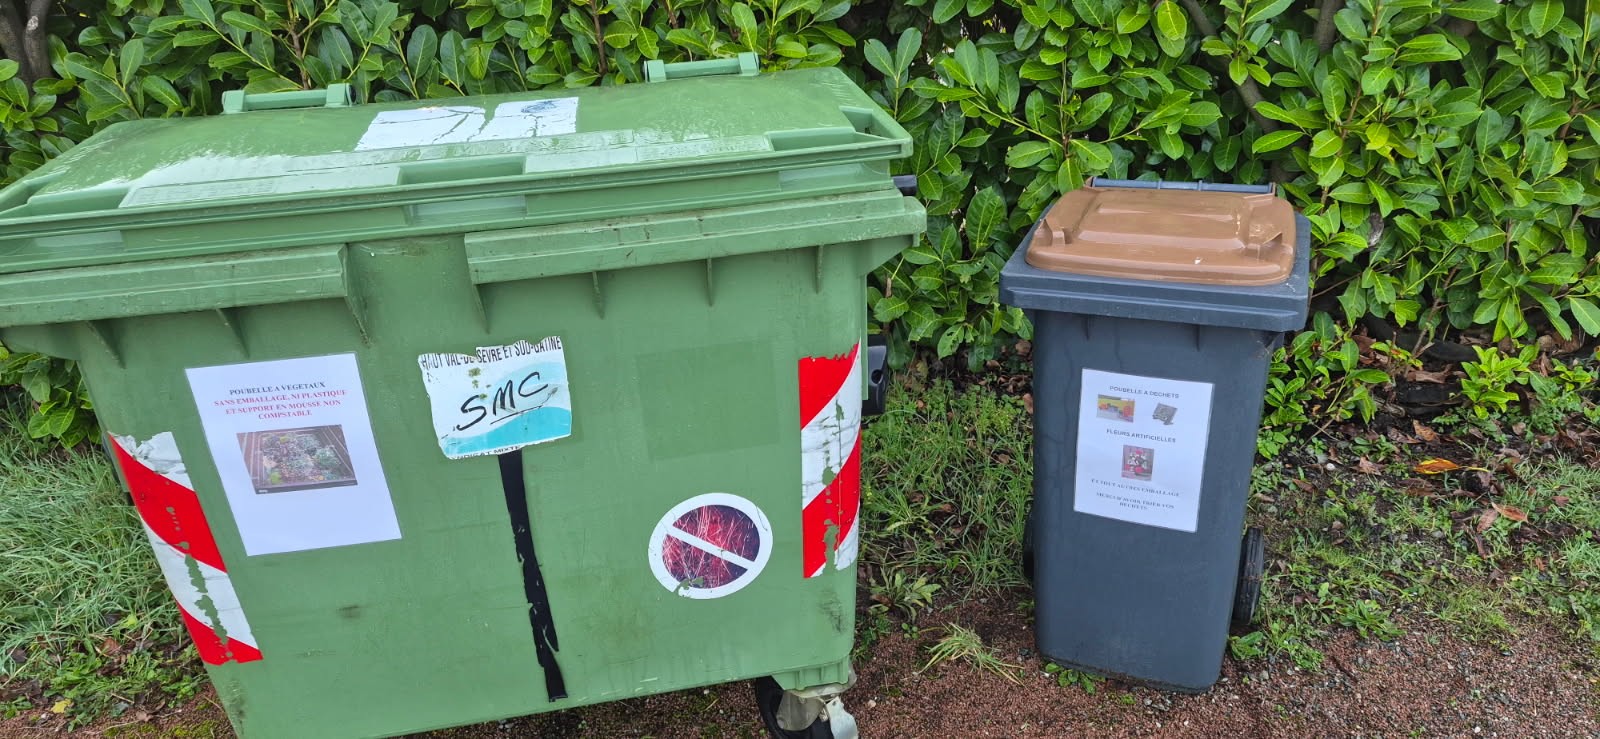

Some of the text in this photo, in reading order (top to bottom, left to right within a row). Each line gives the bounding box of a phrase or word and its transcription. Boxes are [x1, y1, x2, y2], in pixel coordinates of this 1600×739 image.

[229, 386, 274, 396] POUBELLE
[280, 381, 326, 391] VEGETAUX
[1109, 385, 1142, 395] POUBELLE
[1150, 390, 1179, 399] DECHETS
[214, 399, 235, 407] SANS
[236, 394, 290, 405] EMBALLAGE,
[301, 389, 347, 399] PLASTIQUE
[456, 371, 548, 431] SMC
[238, 405, 273, 414] SUPPORT
[288, 400, 321, 410] MOUSSE
[323, 399, 341, 407] NON
[258, 409, 312, 420] COMPSTABLE
[1106, 428, 1176, 443] FLEURS ARTIFICIELLES
